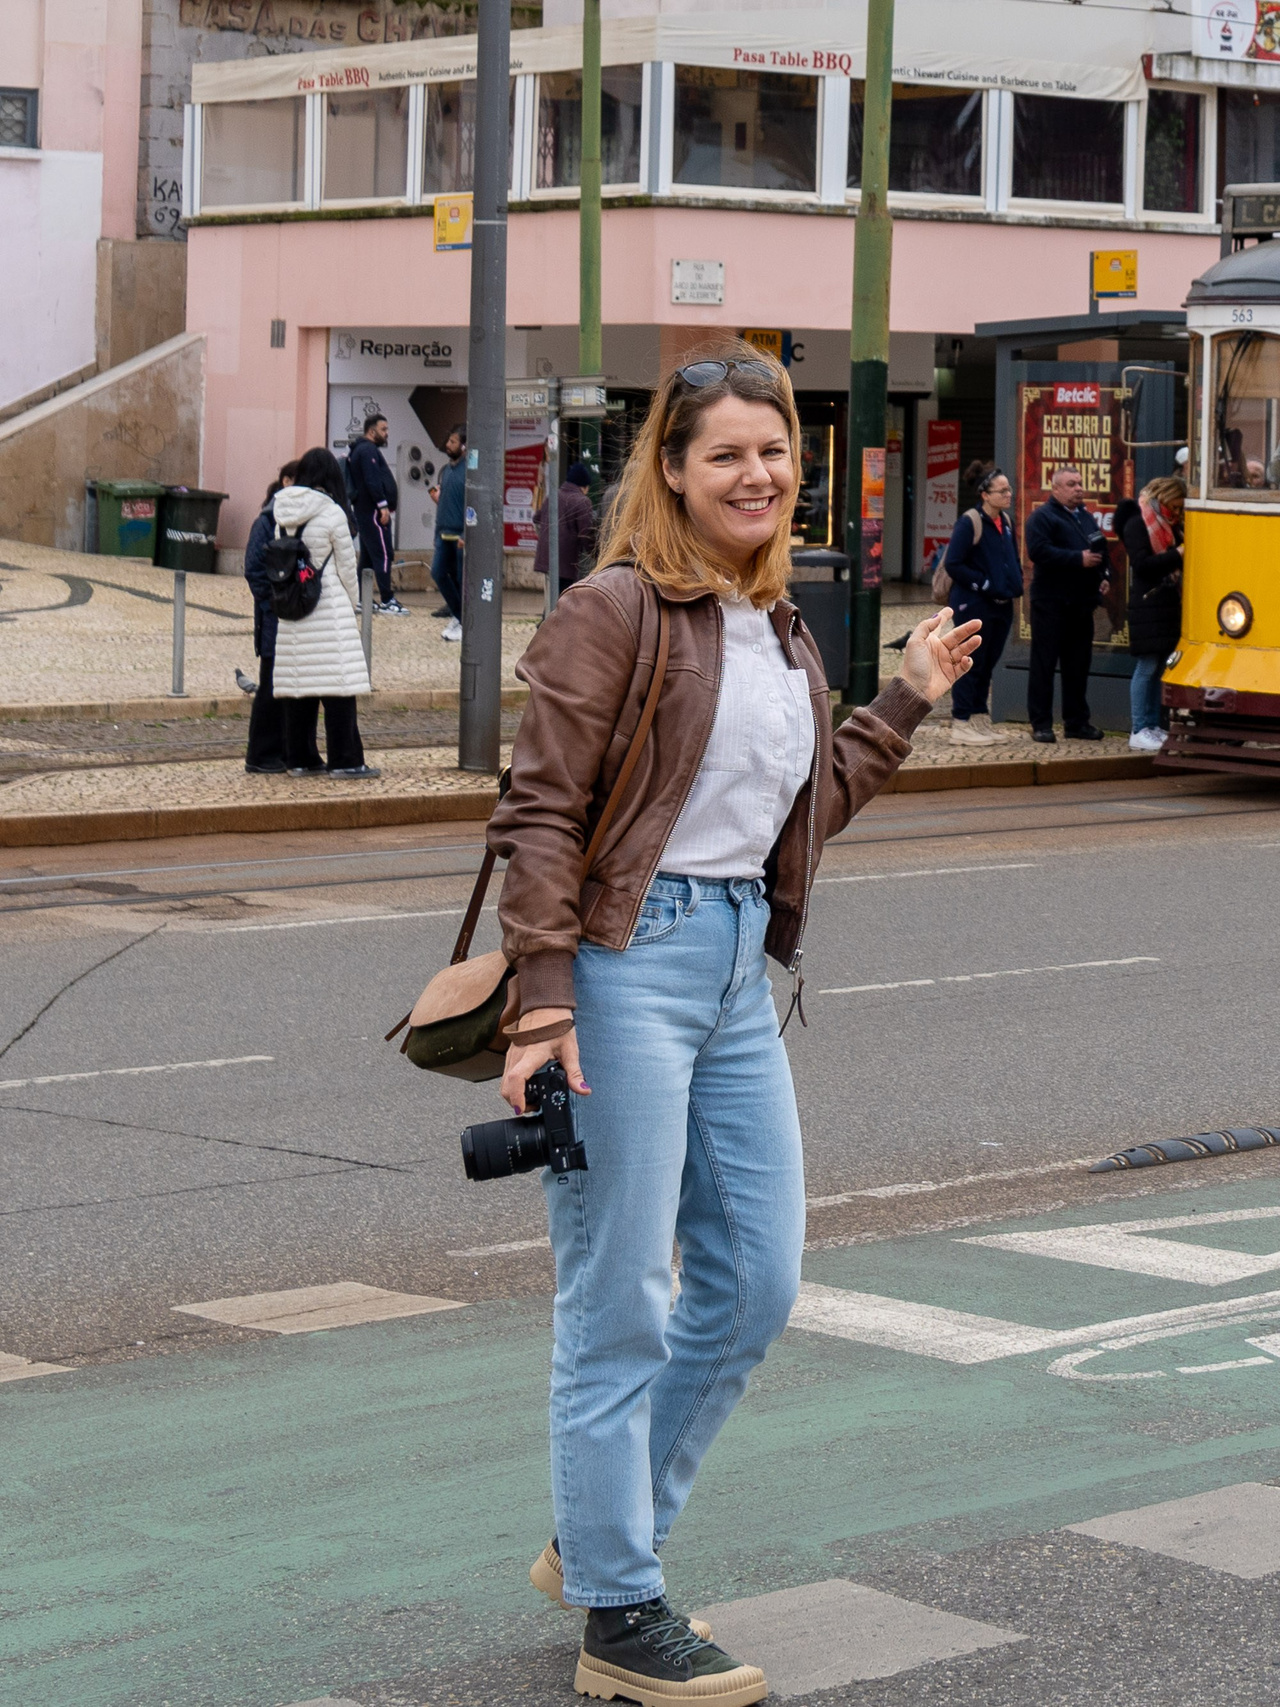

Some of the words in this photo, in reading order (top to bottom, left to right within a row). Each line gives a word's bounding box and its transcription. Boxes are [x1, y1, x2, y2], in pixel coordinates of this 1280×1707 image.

[289, 17, 347, 40] DAS
[378, 69, 406, 81] Authentic
[407, 67, 428, 78] Newari
[429, 66, 451, 77] Cuisine
[453, 64, 465, 74] and
[509, 59, 523, 69] able
[733, 47, 766, 63] Pasa
[770, 51, 809, 67] Table
[812, 50, 852, 75] BBQ
[297, 77, 315, 90] Pasa
[318, 72, 344, 87] Table
[344, 67, 370, 87] BBQ
[913, 67, 944, 79] Newari
[947, 70, 979, 82] Cuisine
[981, 74, 998, 84] and
[1000, 75, 1040, 88] Barbecue
[1042, 81, 1053, 89] on
[1056, 80, 1077, 92] Table
[1232, 308, 1254, 323] 563
[360, 339, 452, 359] Reparação
[751, 333, 777, 346] ATM
[1056, 387, 1098, 403] Betclic
[1043, 415, 1099, 436] CELEBRA
[1103, 416, 1112, 435] O
[1042, 437, 1069, 458] ANO
[1074, 438, 1111, 460] NOVO
